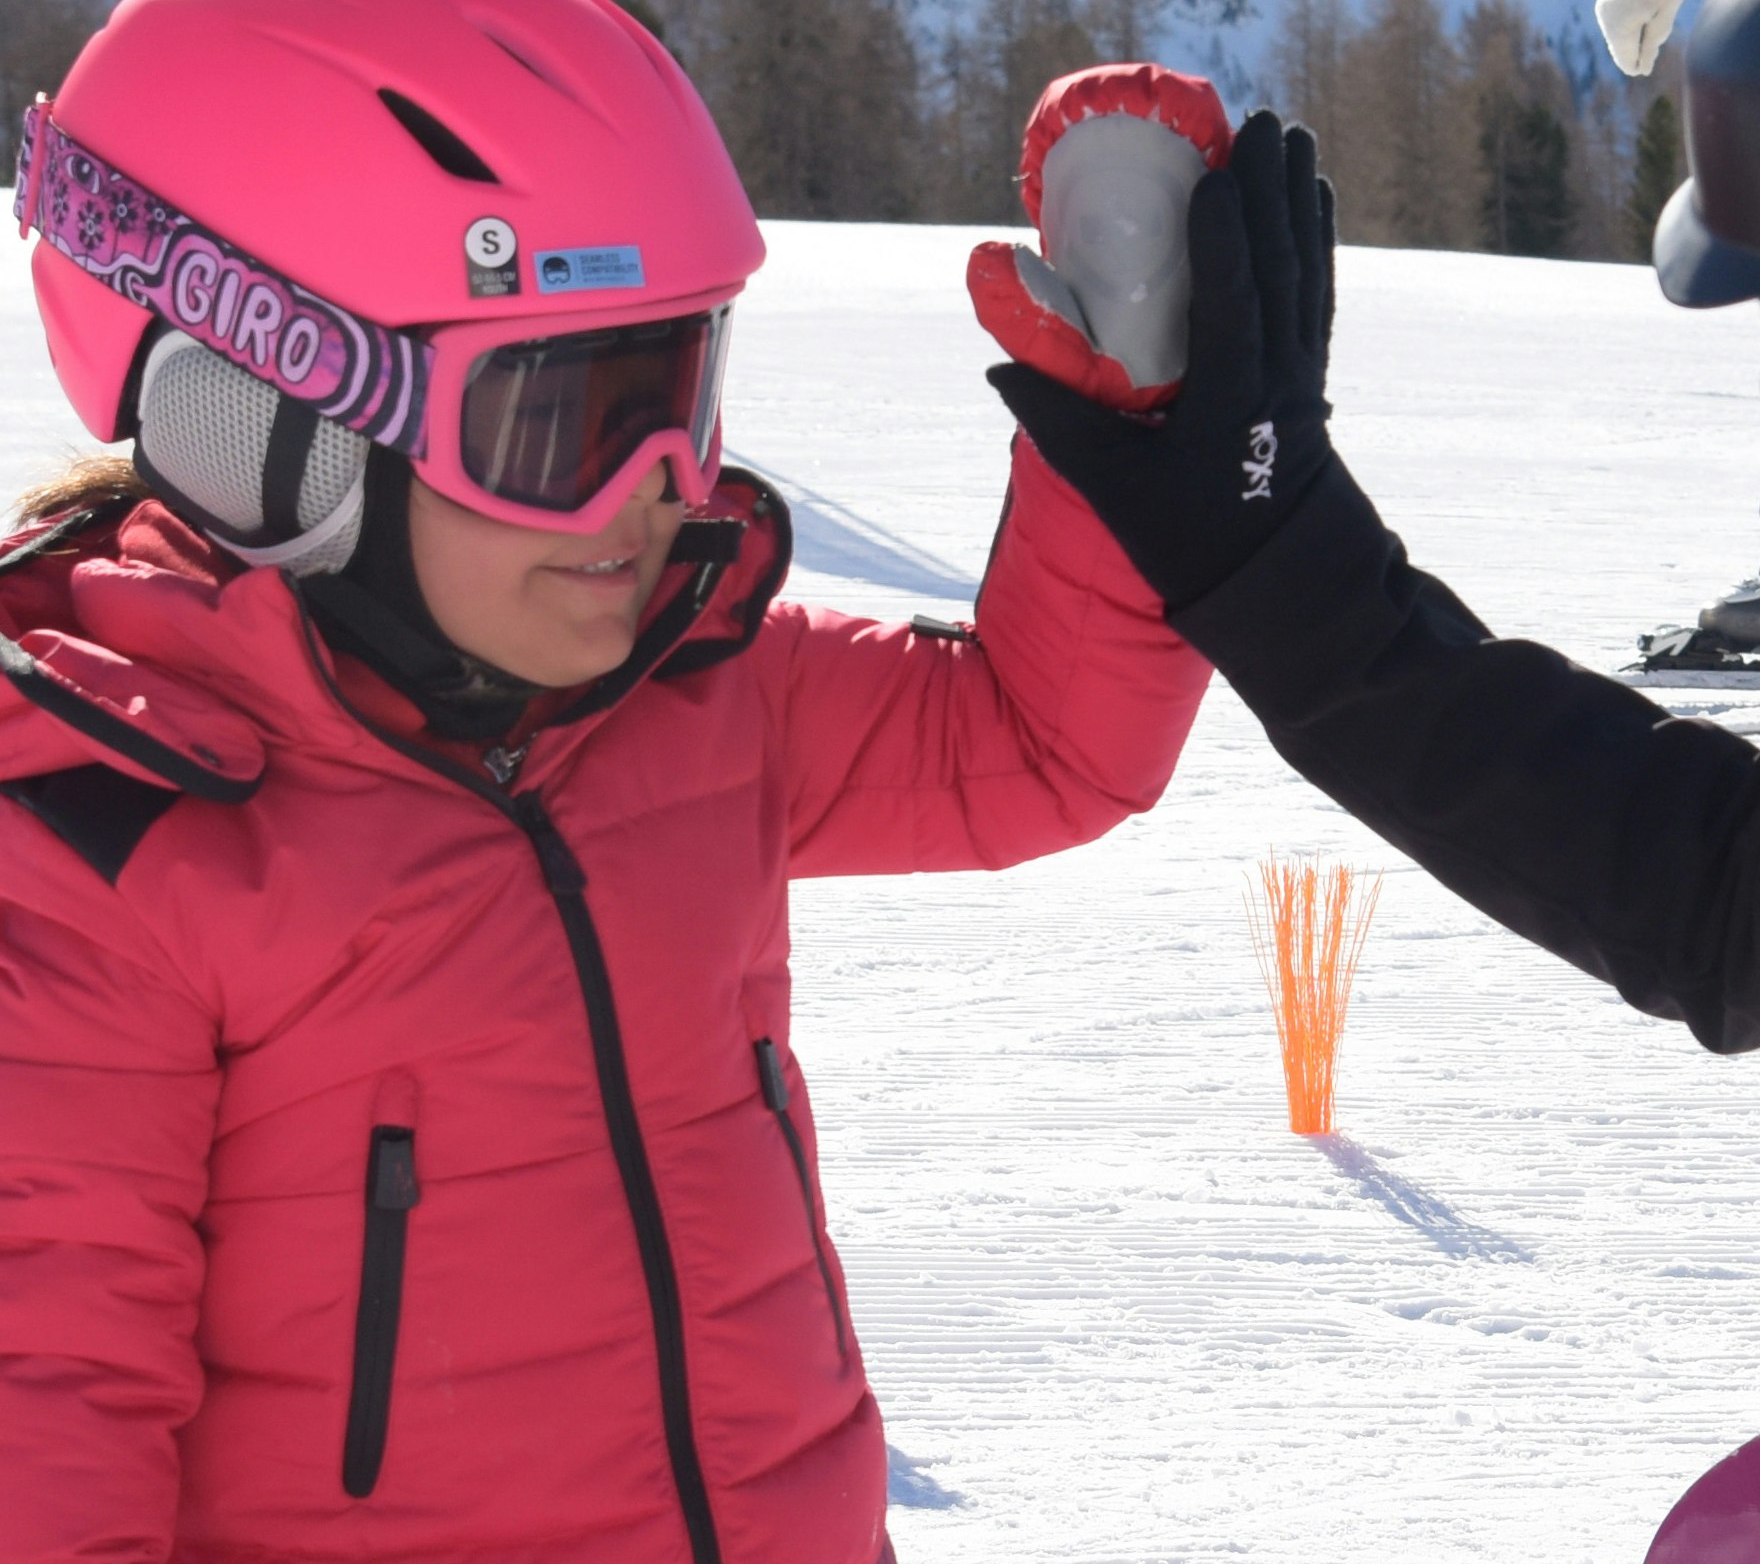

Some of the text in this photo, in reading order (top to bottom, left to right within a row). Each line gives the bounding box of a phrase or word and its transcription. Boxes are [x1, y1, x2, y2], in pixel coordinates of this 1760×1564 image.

[482, 229, 501, 255] S
[173, 251, 321, 383] GIRO
[1242, 421, 1277, 500] ROXY
